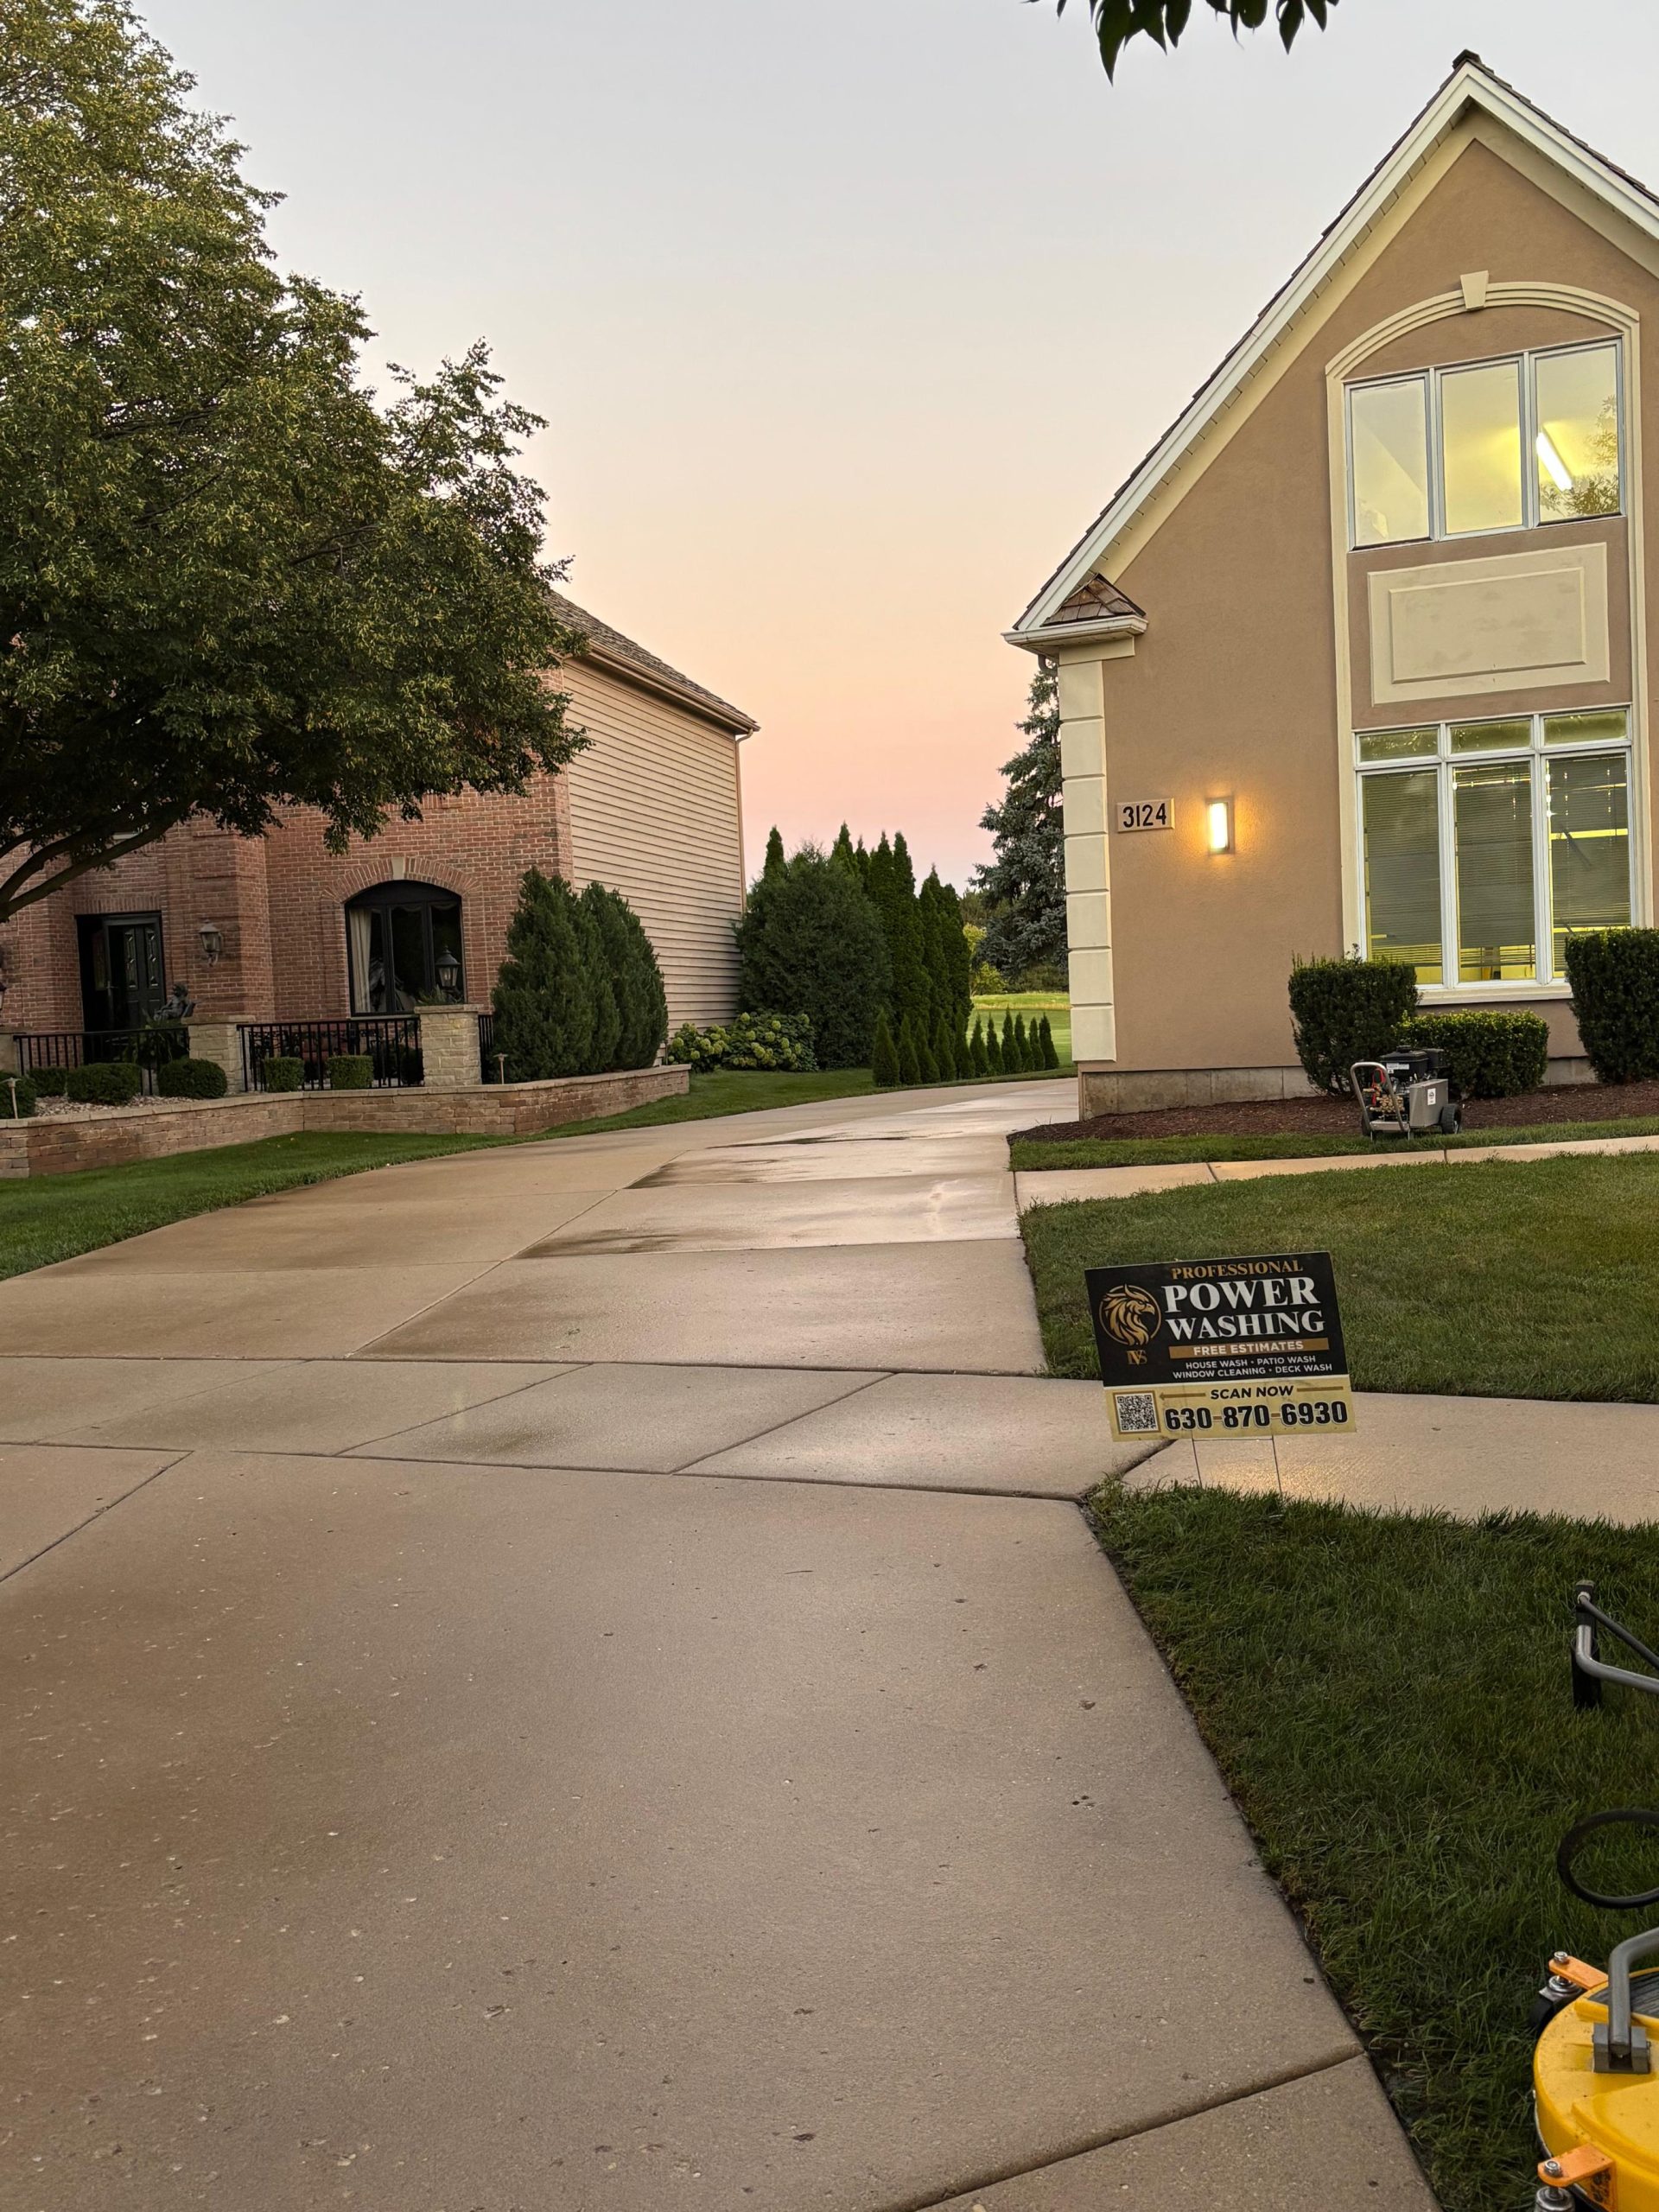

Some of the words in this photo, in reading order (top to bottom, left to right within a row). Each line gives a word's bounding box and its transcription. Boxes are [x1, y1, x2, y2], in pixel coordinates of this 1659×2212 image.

[1123, 803, 1166, 828] 3124
[1171, 1260, 1303, 1280] PROFESSIONAL
[1161, 1276, 1321, 1313] POWER
[1166, 1310, 1325, 1340] WASHING
[1193, 1344, 1227, 1356] FREE
[1230, 1340, 1304, 1354] ESTIMATES
[1173, 1370, 1215, 1379] WINDOW
[1217, 1367, 1266, 1377] CLEANING
[1275, 1365, 1301, 1374] DECK
[1304, 1363, 1332, 1372] WASH
[1185, 1361, 1217, 1370] HOUSE
[1220, 1359, 1248, 1368] WASH
[1287, 1355, 1316, 1363] WASH
[1211, 1388, 1252, 1400] SCAN
[1256, 1385, 1294, 1397] NOW
[1165, 1401, 1348, 1431] 630-870-6930
